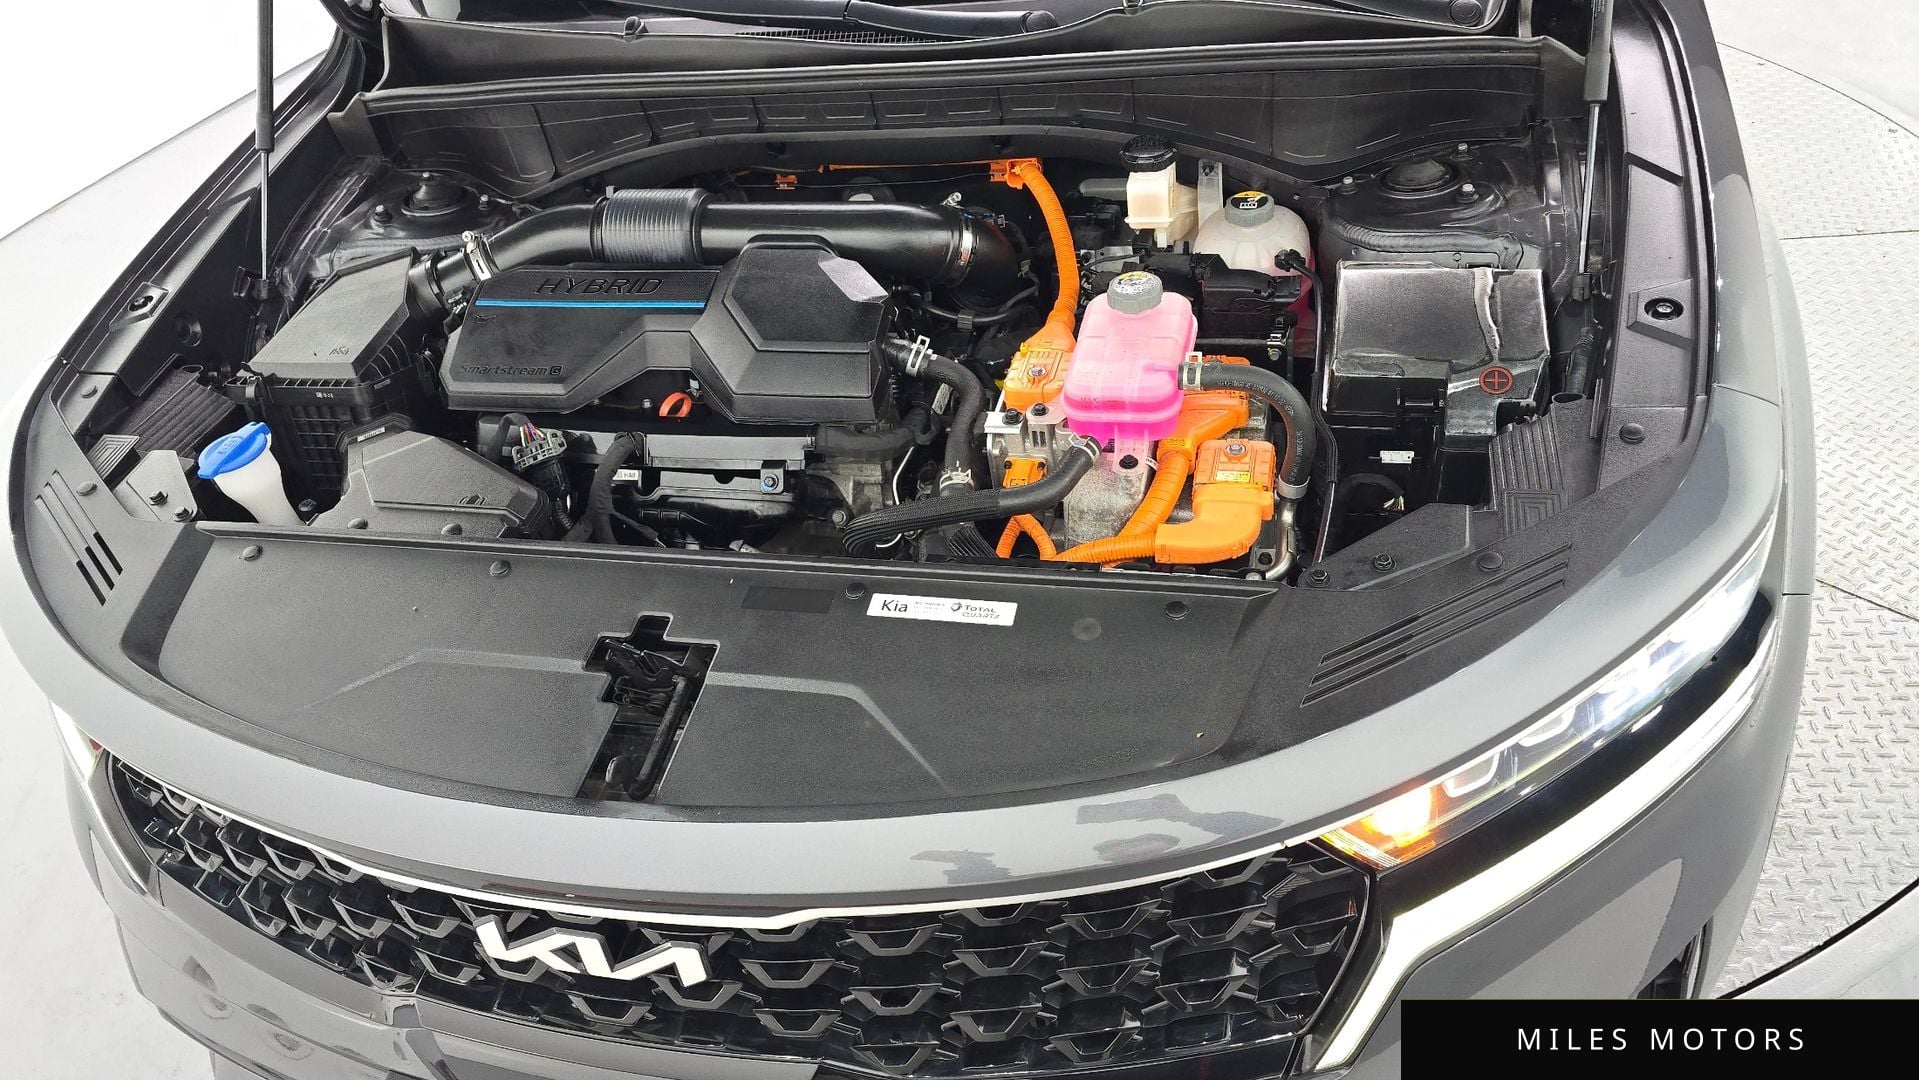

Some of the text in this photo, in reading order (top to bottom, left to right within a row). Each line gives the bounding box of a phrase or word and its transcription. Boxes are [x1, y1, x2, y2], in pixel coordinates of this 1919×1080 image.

[534, 278, 664, 295] HYBRID
[457, 364, 548, 377] Smartstream
[881, 599, 908, 613] Kia
[964, 604, 998, 614] TOTAL
[474, 914, 713, 988] KIA
